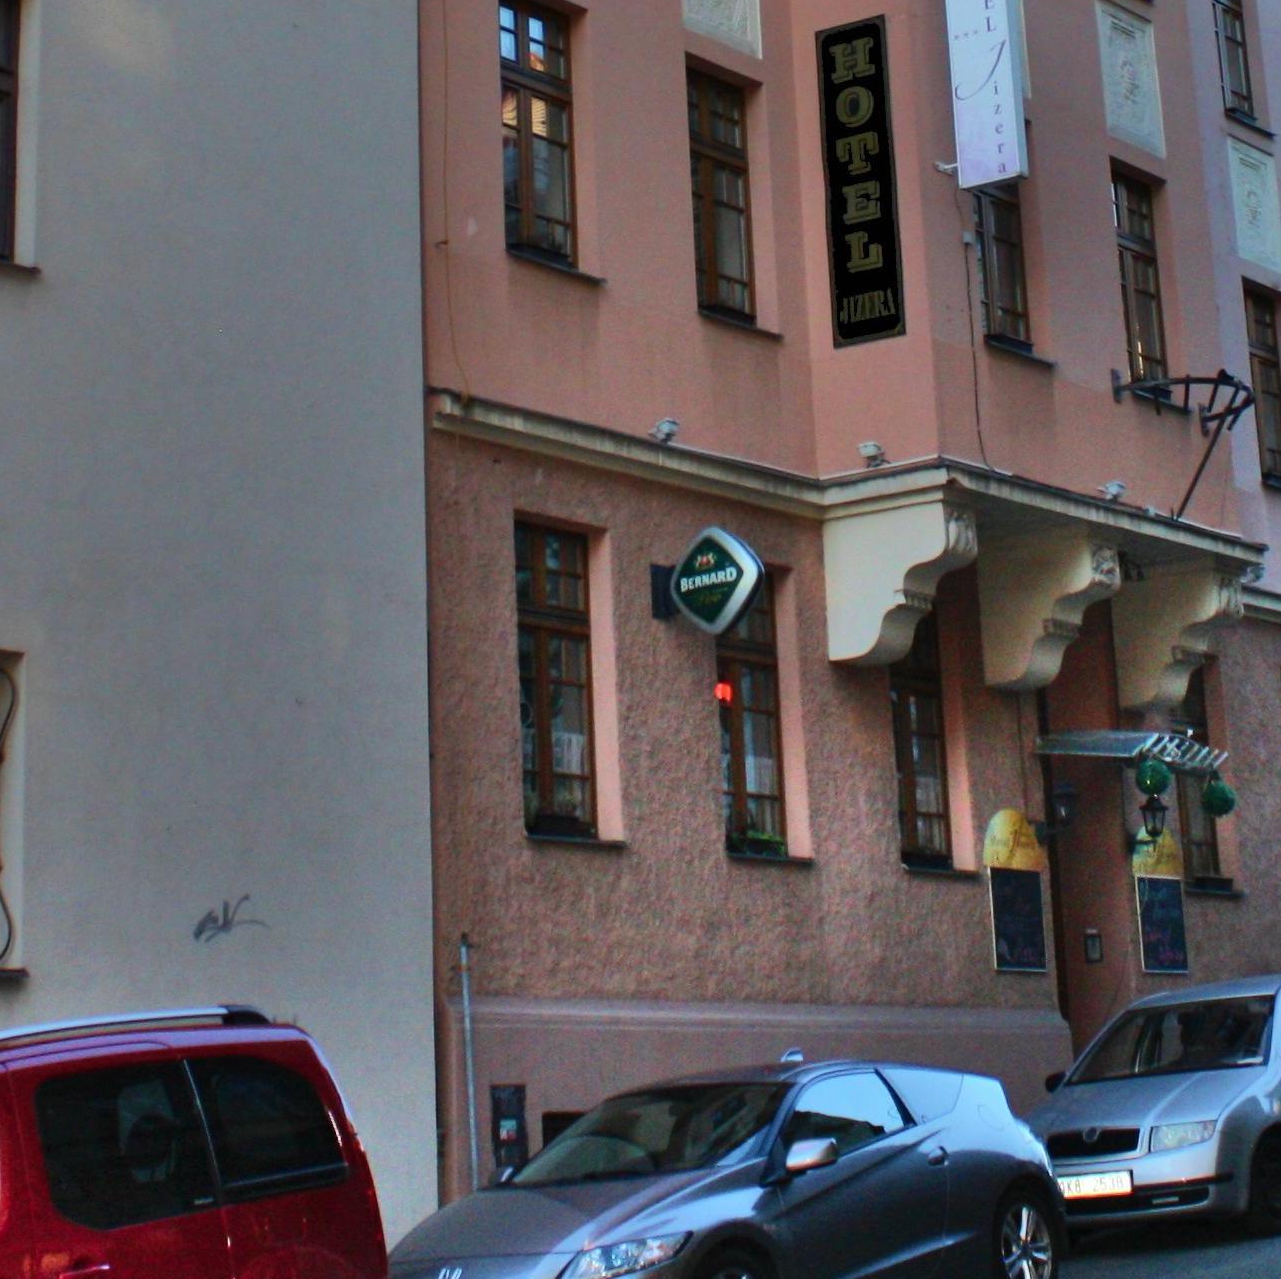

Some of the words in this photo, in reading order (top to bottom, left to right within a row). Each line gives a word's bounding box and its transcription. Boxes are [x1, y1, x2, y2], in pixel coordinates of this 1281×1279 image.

[954, 39, 1007, 174] Jizera
[830, 36, 883, 273] HOTEL
[839, 288, 896, 324] JIZERA
[680, 566, 737, 593] BERNARD
